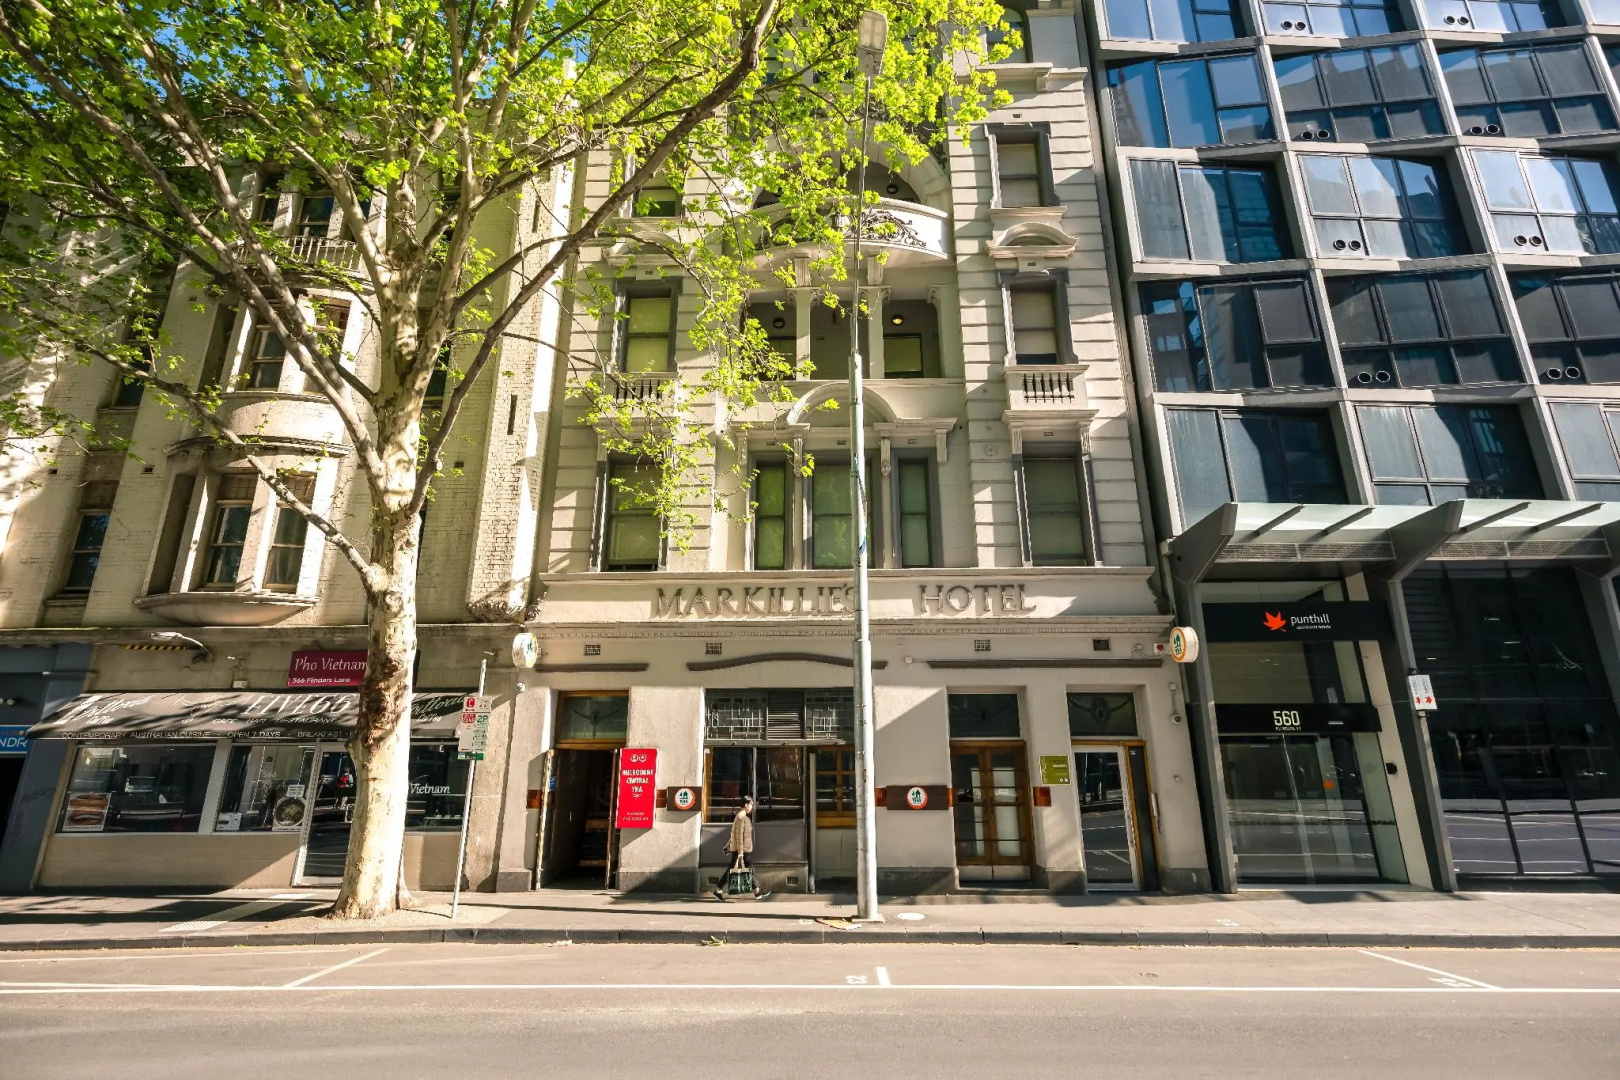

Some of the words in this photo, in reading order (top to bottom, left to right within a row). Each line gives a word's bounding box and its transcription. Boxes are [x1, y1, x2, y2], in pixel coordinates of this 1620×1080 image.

[918, 584, 1037, 612] HOTEL
[1290, 613, 1330, 627] punthill
[294, 656, 317, 671] Pho
[321, 657, 368, 671] Vietnam
[306, 676, 333, 684] Flinders
[477, 715, 489, 723] 2P
[1273, 711, 1300, 726] 560
[410, 782, 450, 794] Vietnam
